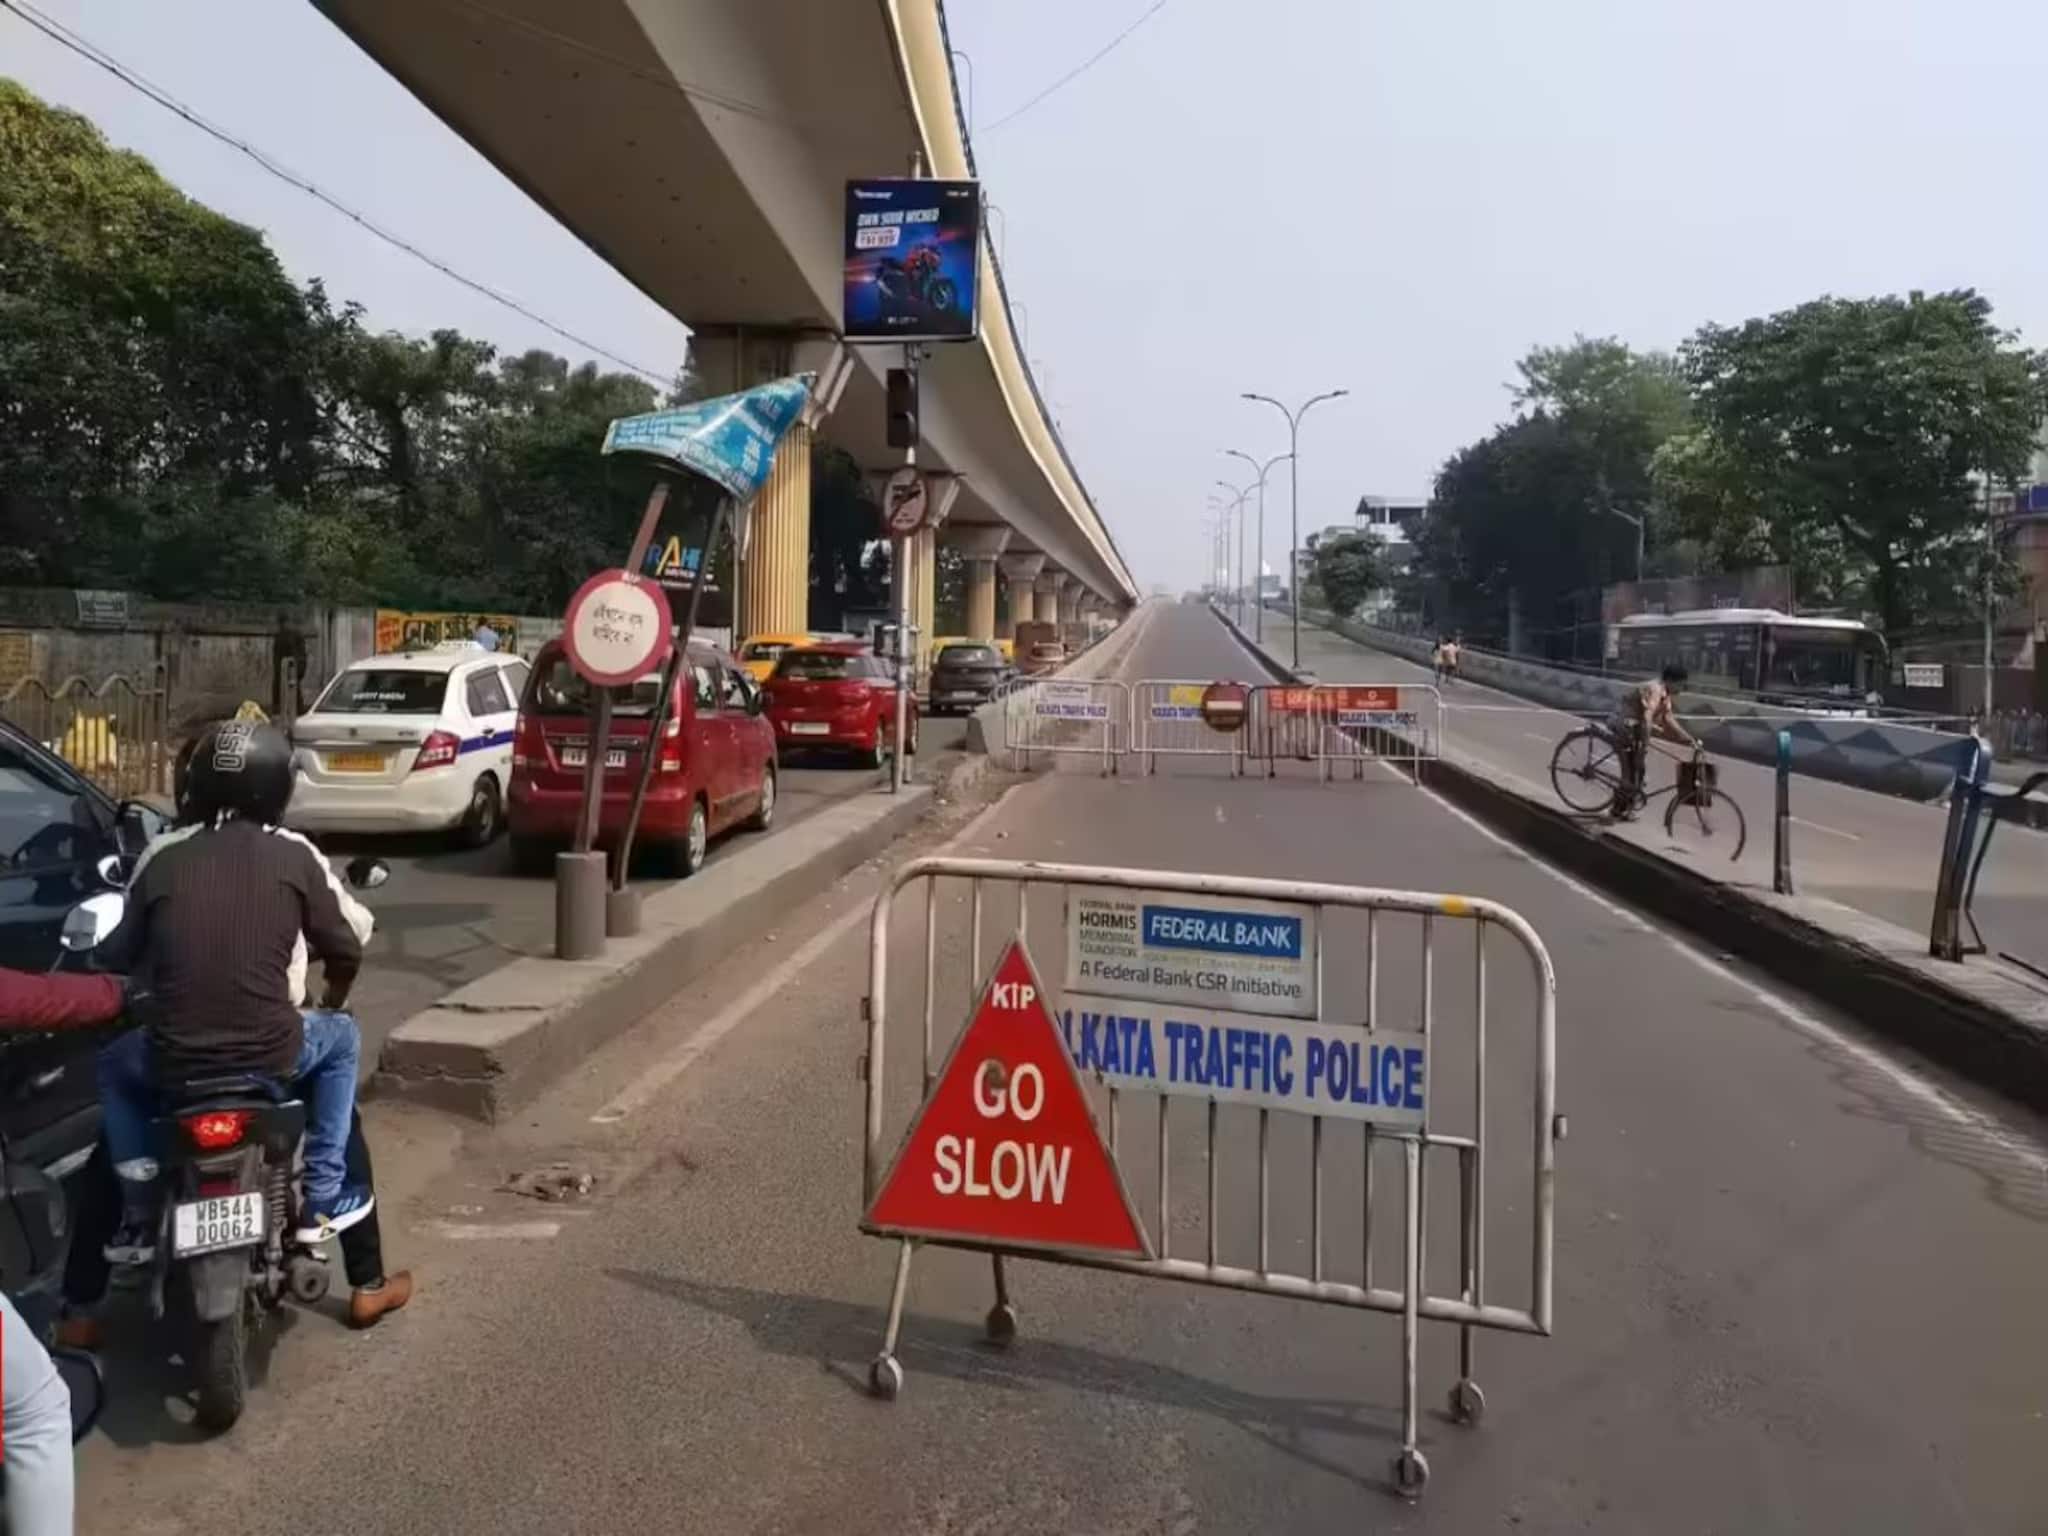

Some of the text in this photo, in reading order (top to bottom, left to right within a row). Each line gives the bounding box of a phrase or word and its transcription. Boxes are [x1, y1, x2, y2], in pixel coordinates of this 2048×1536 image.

[1079, 929, 1135, 945] MEMORIAL
[1080, 911, 1137, 931] HORMIS
[1151, 914, 1294, 950] FEDERAL BANK
[991, 981, 1036, 1010] KIP
[1080, 960, 1091, 977] A
[1094, 961, 1149, 983] Federal
[1153, 968, 1193, 989] Bank
[1196, 971, 1228, 990] CSR
[1232, 974, 1302, 999] Initiative
[1056, 1009, 1424, 1110] LKATA TRAFFIC POLICE
[973, 1058, 1045, 1121] GO
[932, 1134, 1072, 1205] SLOW
[195, 1195, 253, 1222] WB54A
